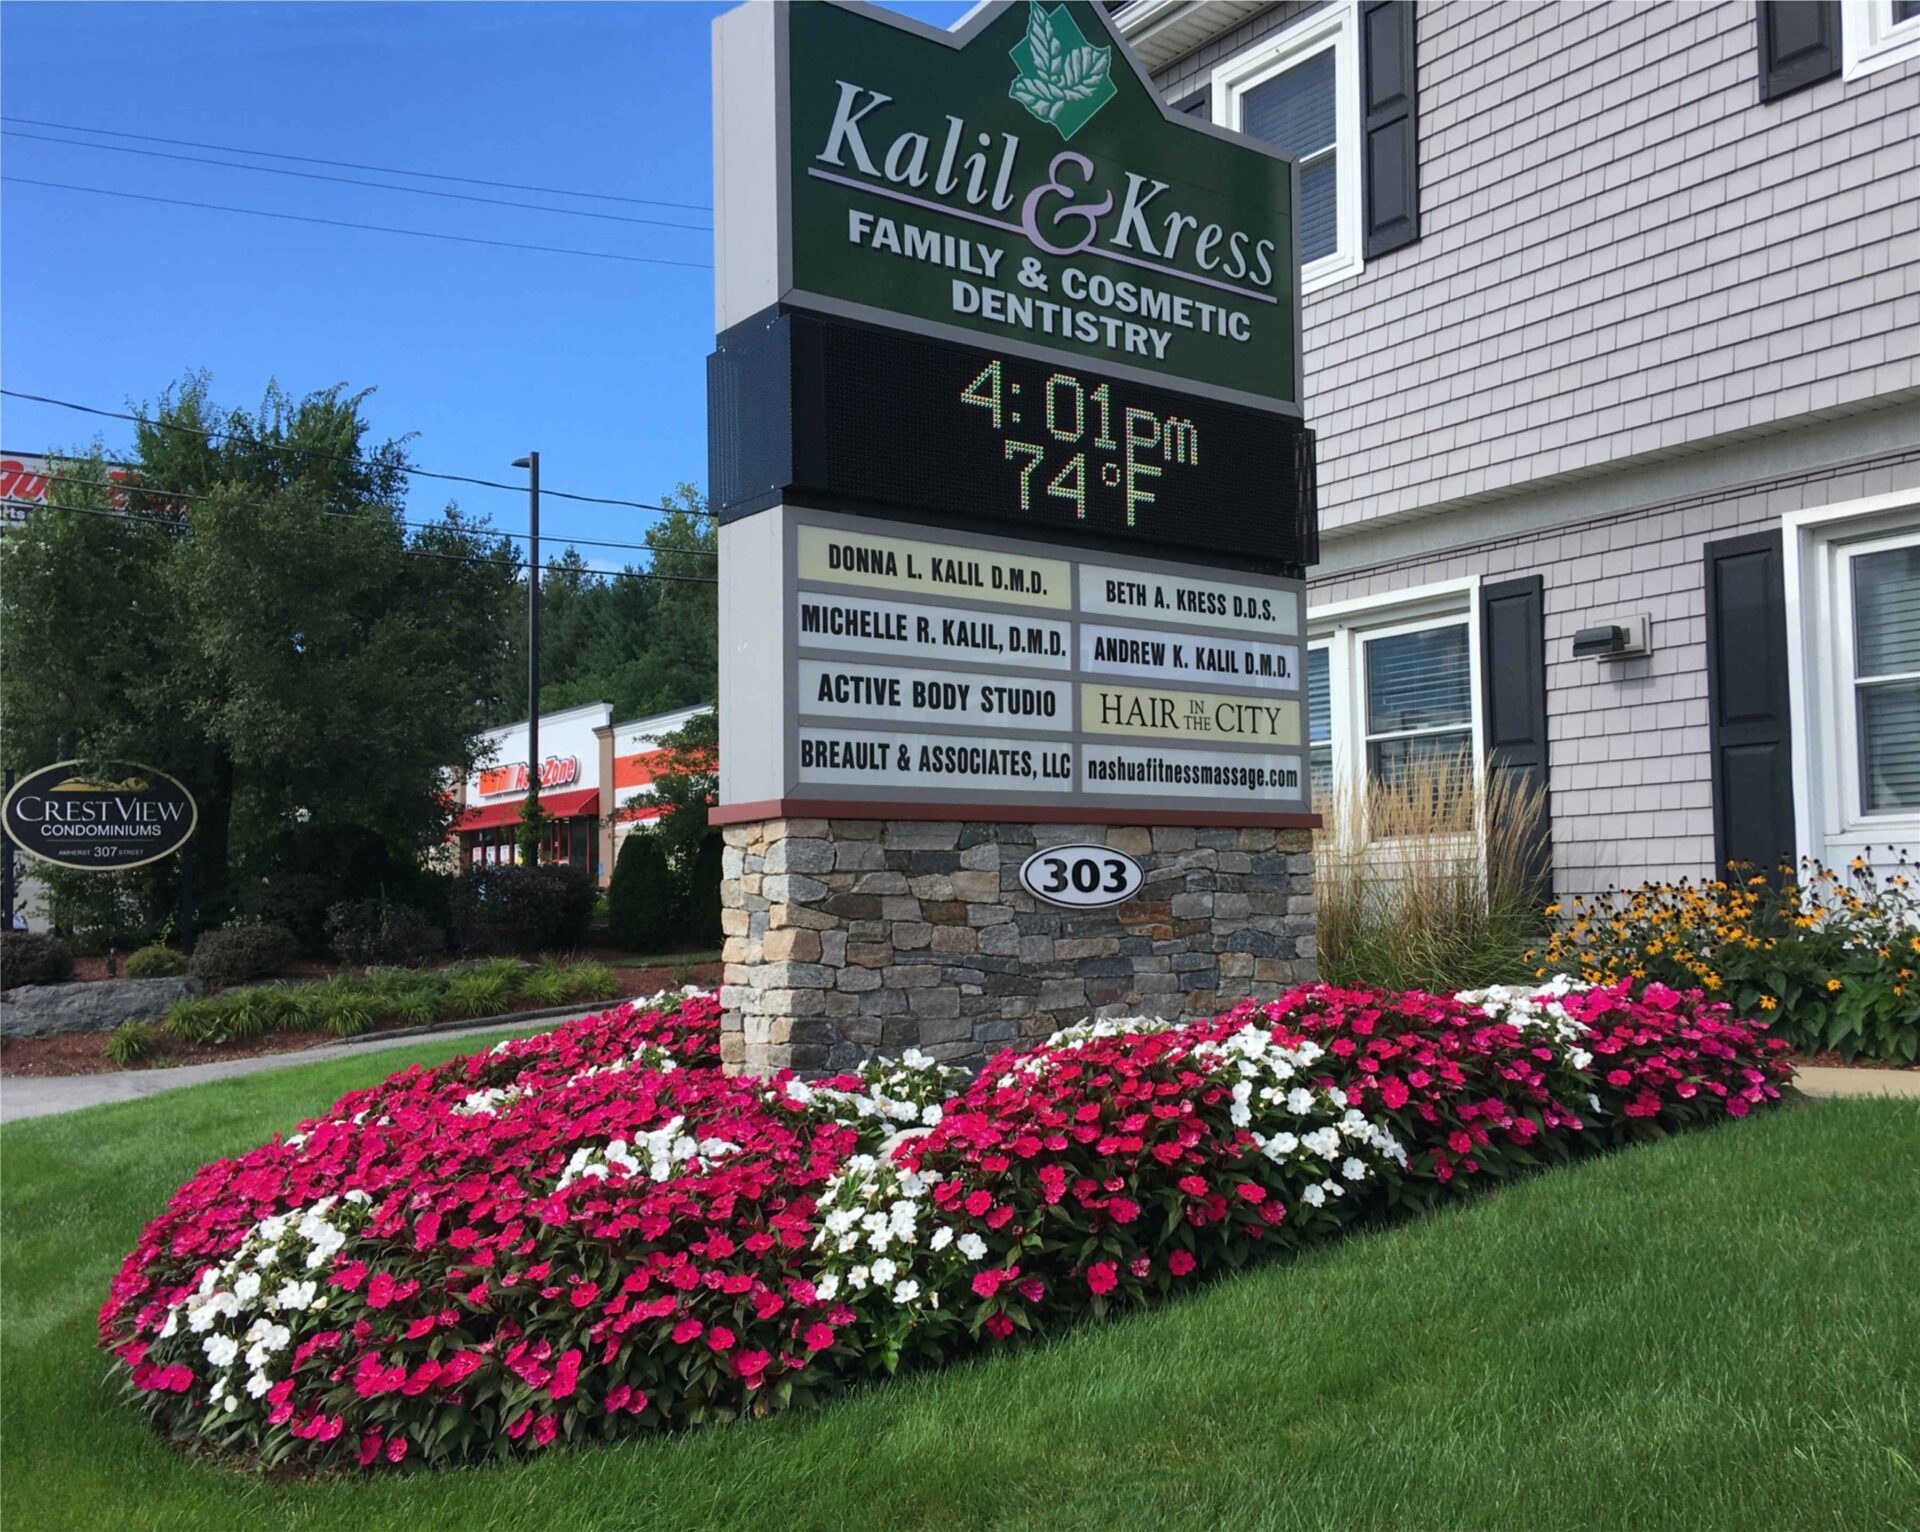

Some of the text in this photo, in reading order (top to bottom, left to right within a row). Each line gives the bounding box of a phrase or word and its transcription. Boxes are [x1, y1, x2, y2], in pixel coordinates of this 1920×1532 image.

[816, 79, 1275, 287] Kalil & Kress
[848, 209, 1251, 342] FAMILY & COSMETIC
[951, 279, 1173, 360] DENTISTRY
[828, 543, 1047, 595] DONNA L. KALIL D.M.D.
[1105, 579, 1276, 622] BETH A. KRESS D.D.S.
[801, 604, 1067, 657] MICHELLE R. KALIL, D.M.D.
[1094, 636, 1291, 679] ANDREW K. KALIL D.M.D.
[817, 673, 1056, 717] ACTIVE BODY STUDIO
[1099, 693, 1282, 735] HAIR IN THE CITY
[801, 739, 1071, 780] BREAULT & ASSOCIATES, LLC
[1088, 756, 1298, 790] nashuafitnessmassage.com
[40, 824, 162, 837] CONDOMINIUMS
[93, 846, 118, 858] 307
[1043, 858, 1128, 893] 303
